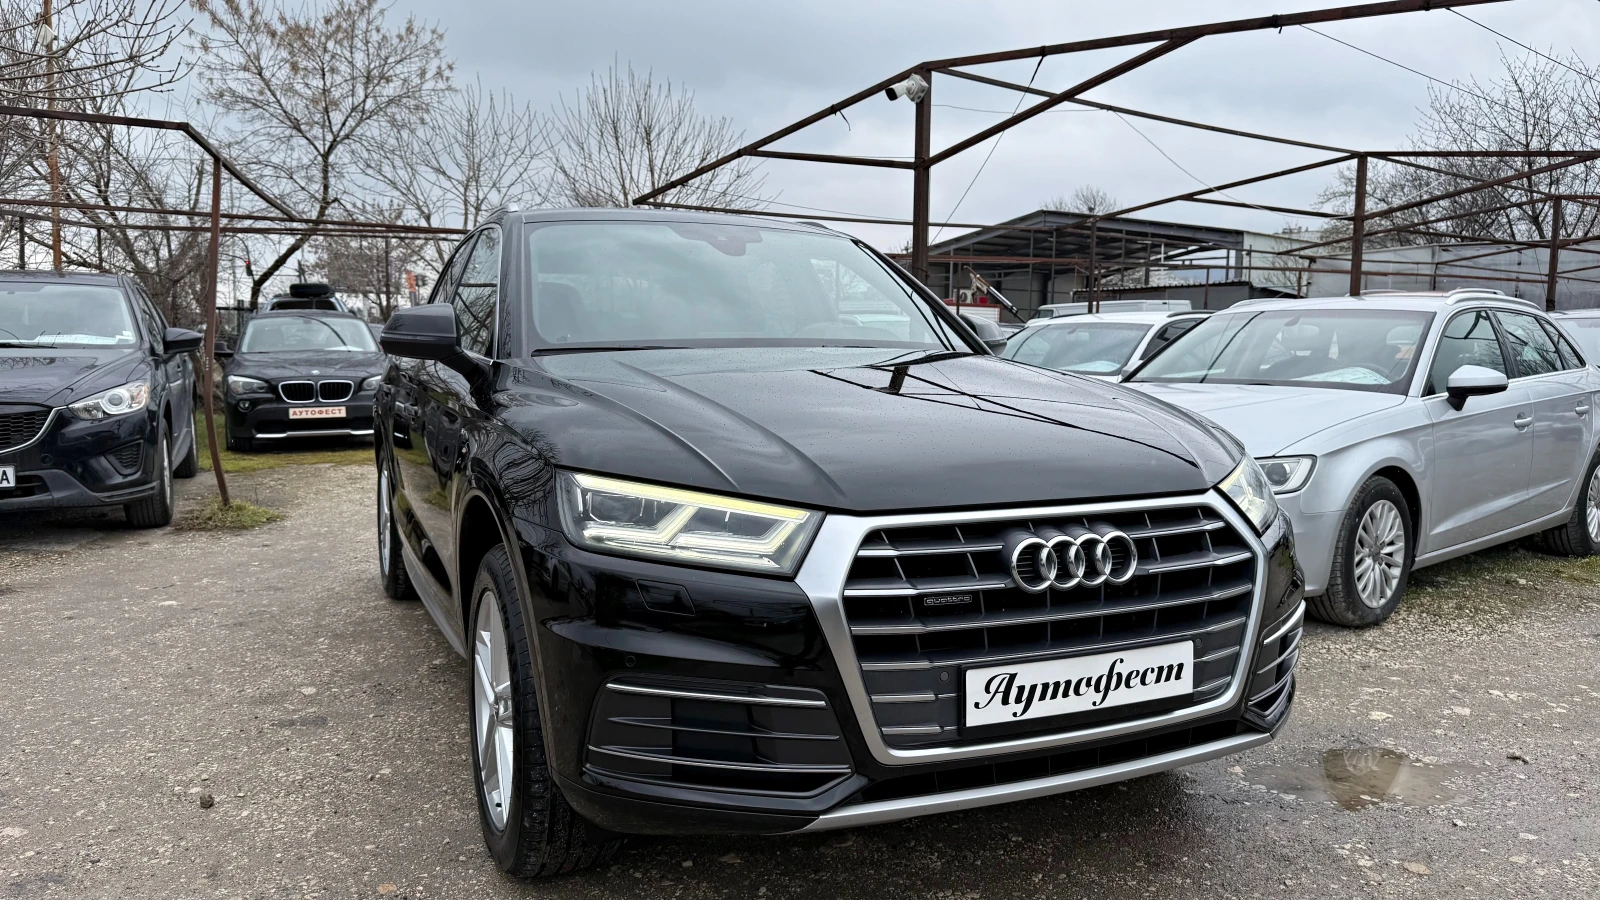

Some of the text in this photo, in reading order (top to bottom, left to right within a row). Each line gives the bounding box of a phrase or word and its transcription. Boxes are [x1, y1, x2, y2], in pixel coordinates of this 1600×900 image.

[291, 408, 343, 417] АУТОФЕСТ
[926, 596, 970, 605] quattro
[973, 657, 1185, 718] Аутофест
